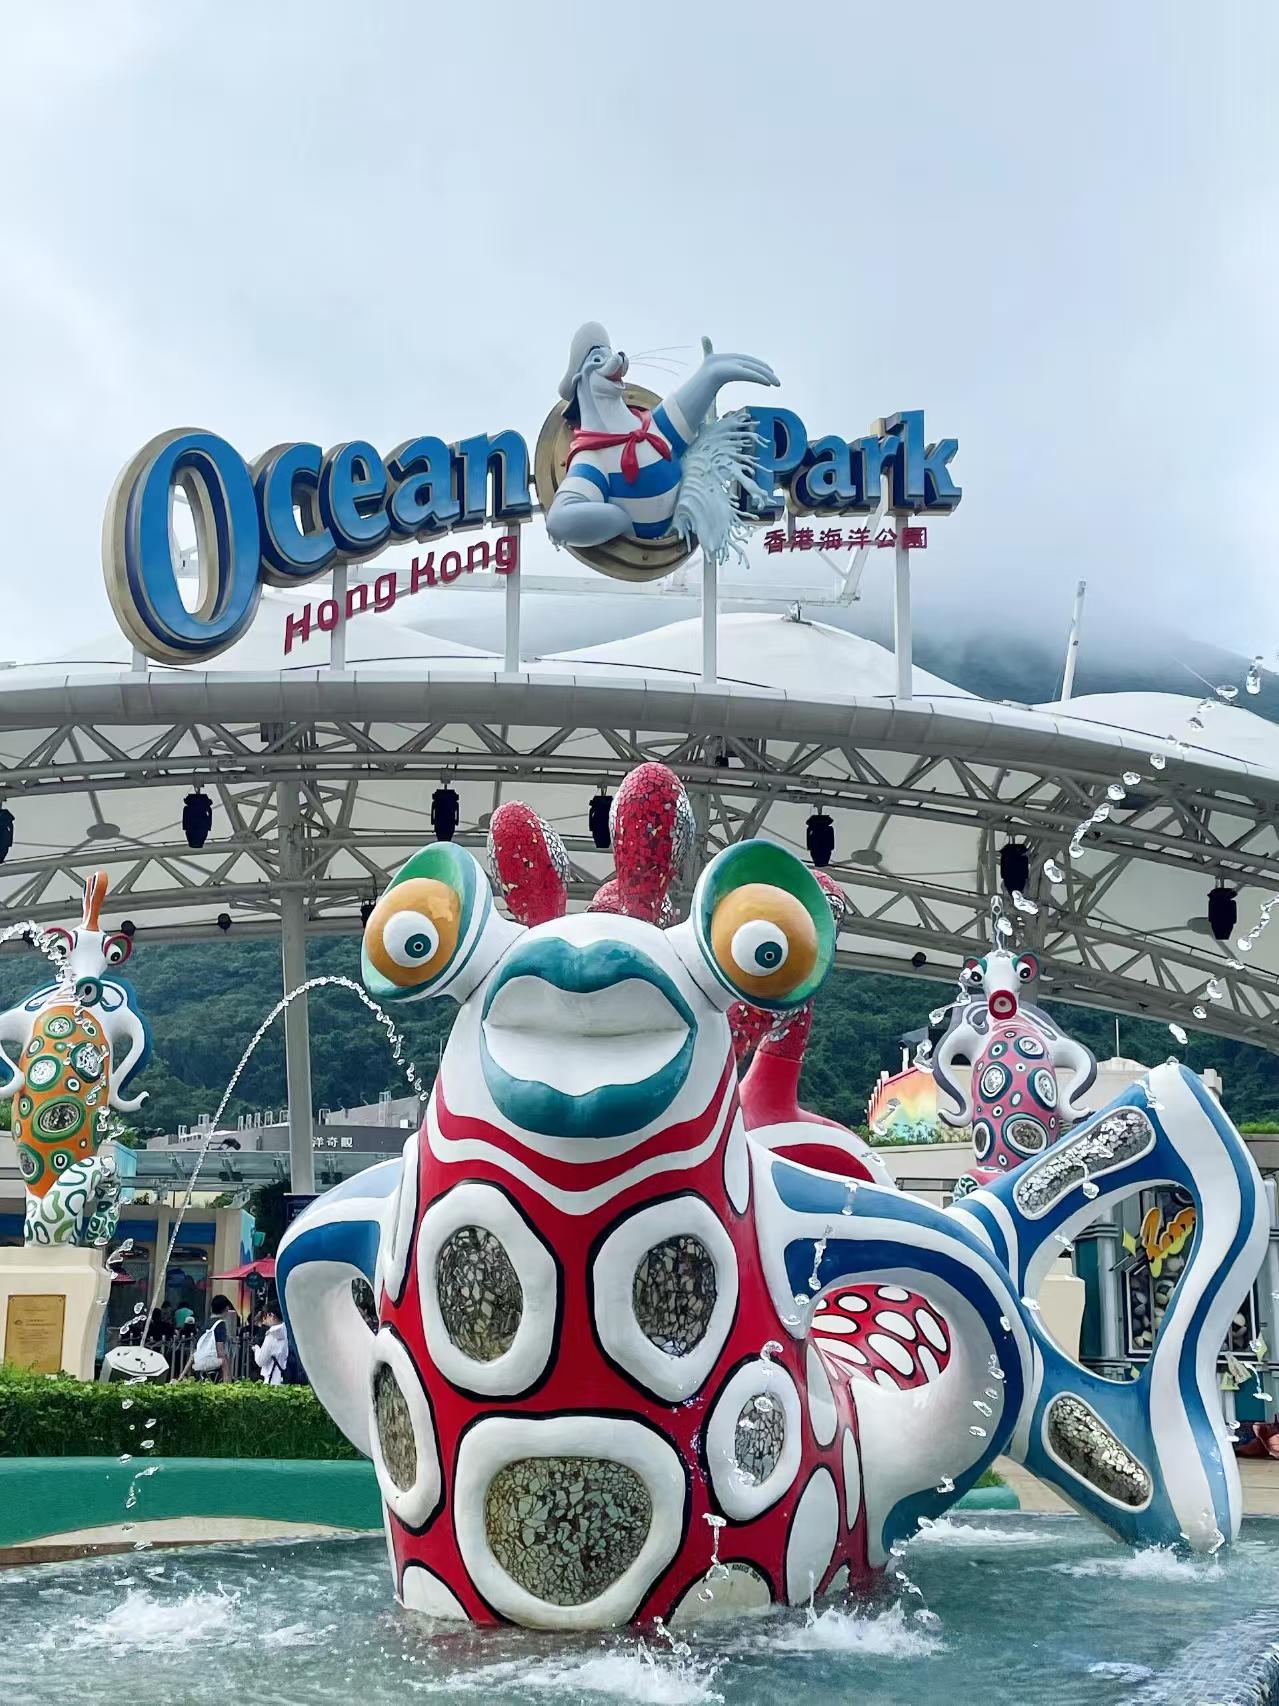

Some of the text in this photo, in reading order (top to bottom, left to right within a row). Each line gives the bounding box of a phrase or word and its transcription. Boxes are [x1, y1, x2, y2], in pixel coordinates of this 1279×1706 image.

[103, 406, 962, 665] Ocean Park
[284, 535, 518, 655] Hong Kong
[763, 526, 928, 554] 香港海洋公園
